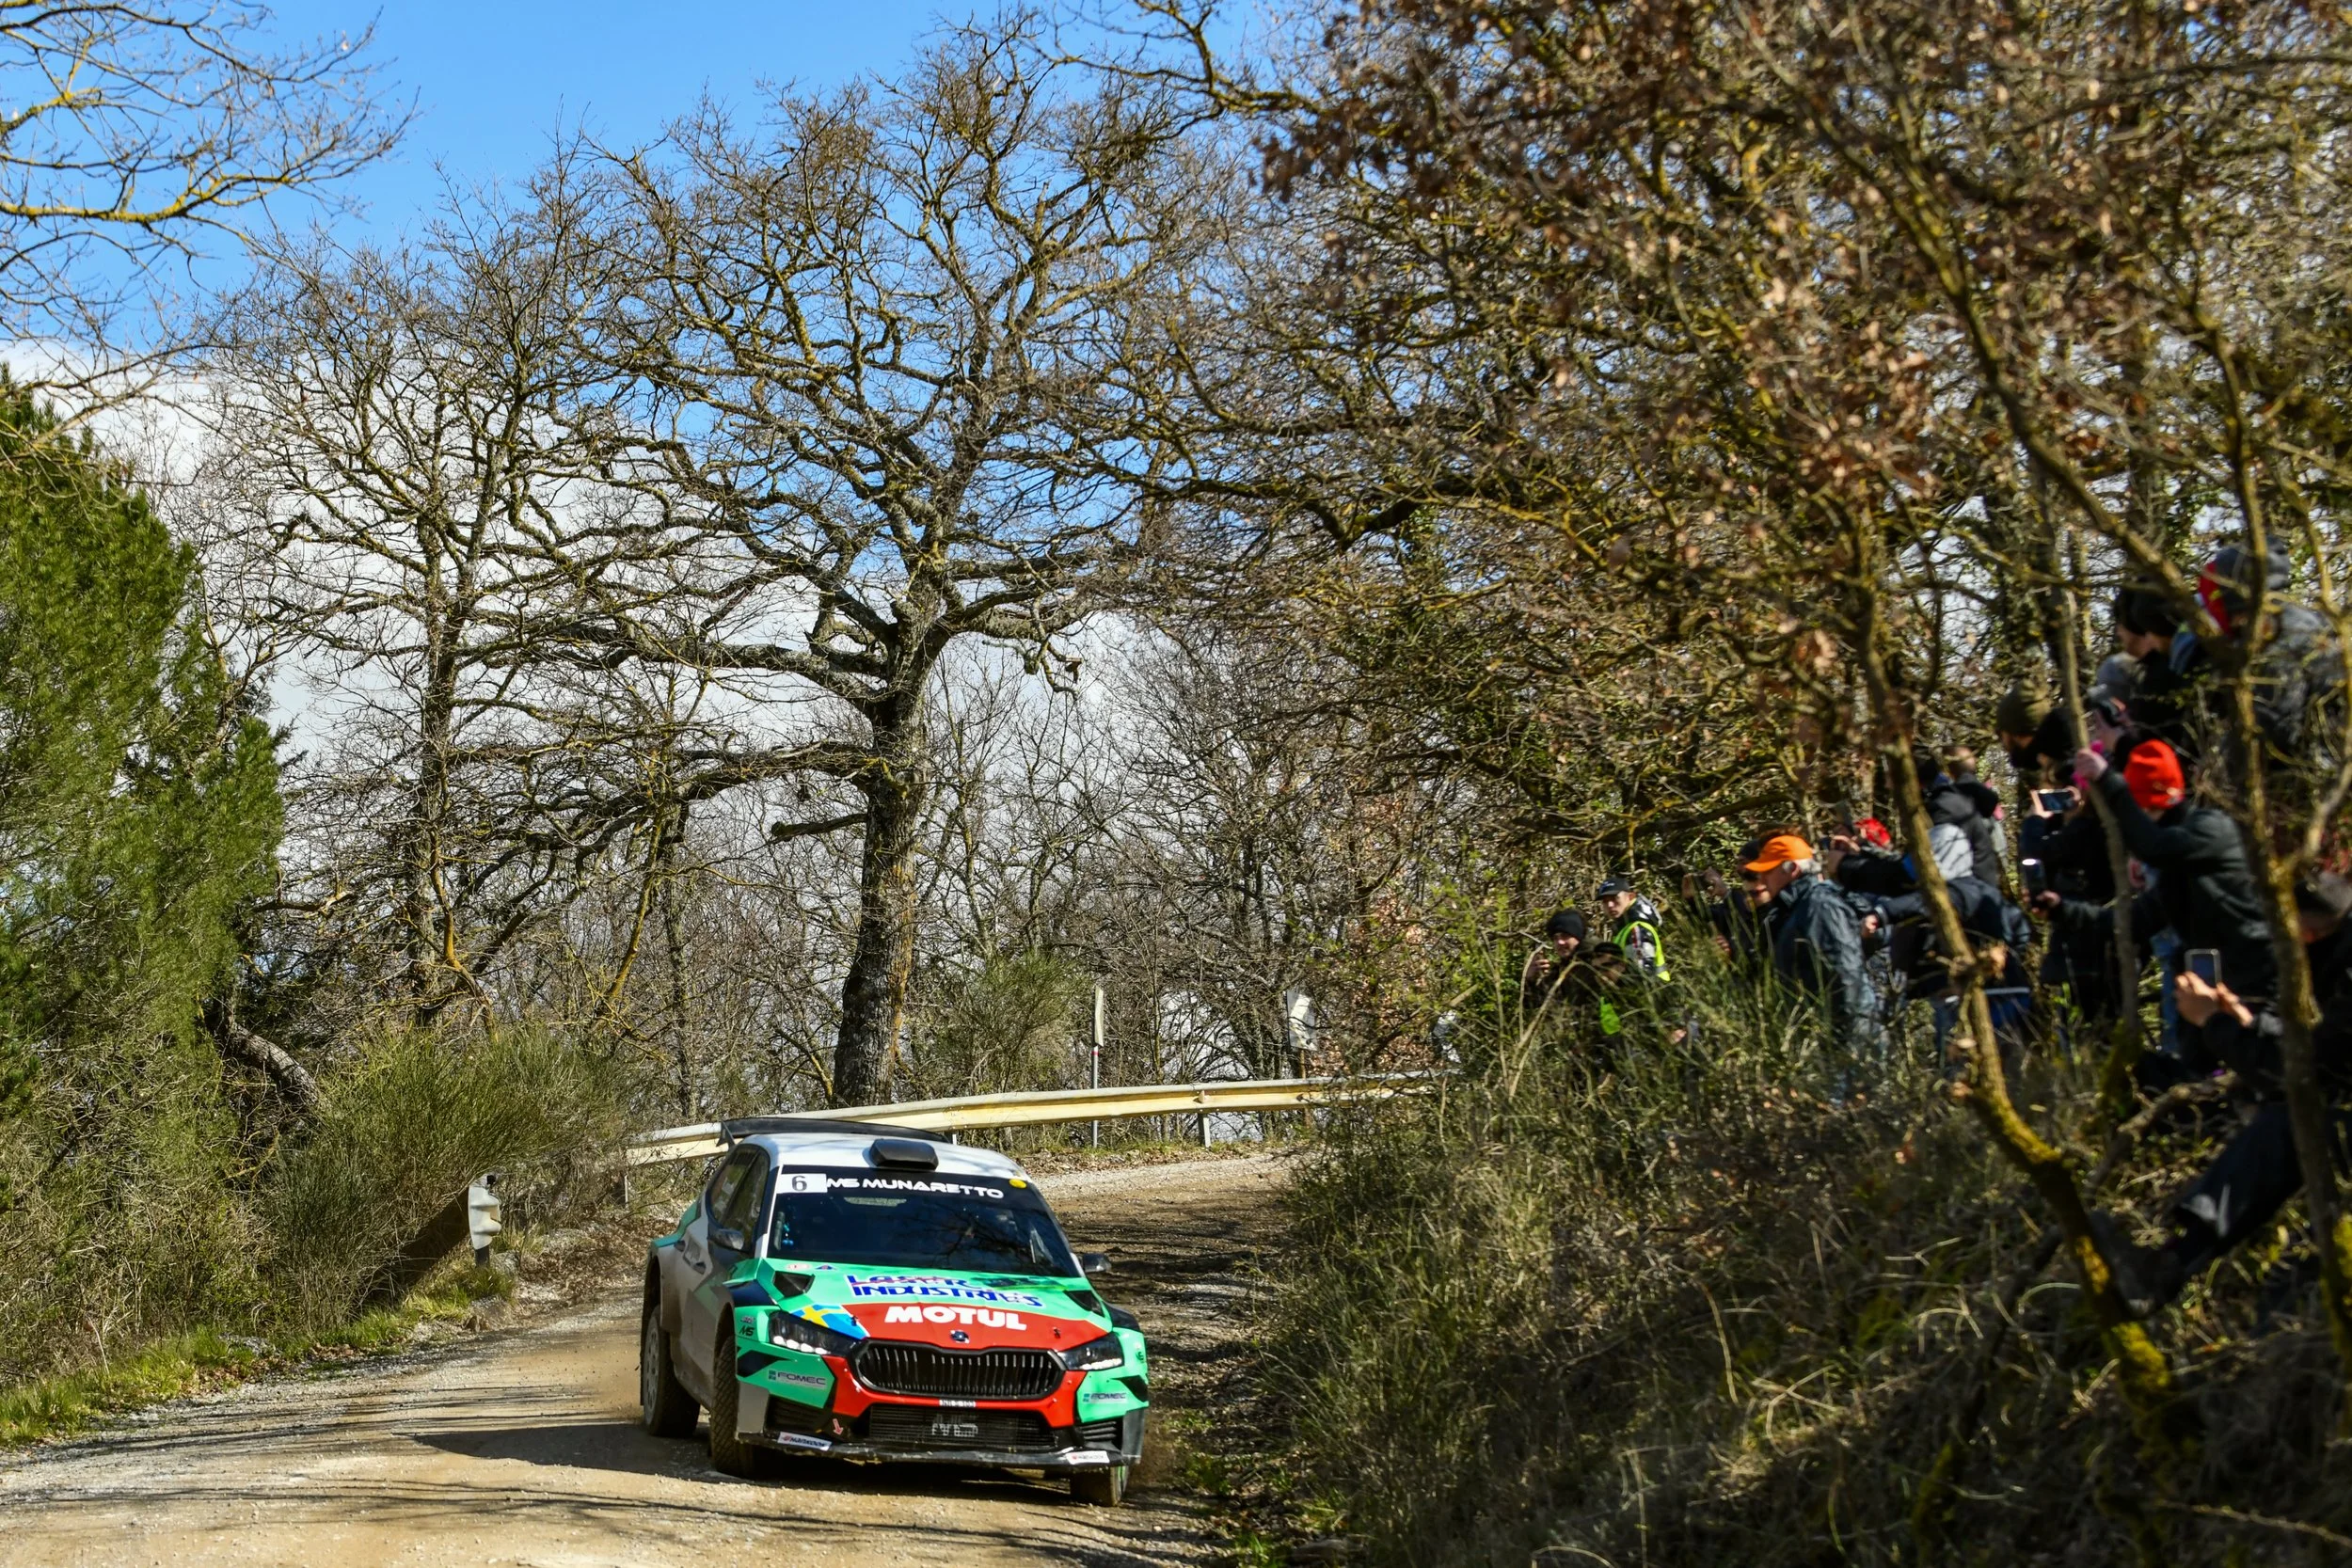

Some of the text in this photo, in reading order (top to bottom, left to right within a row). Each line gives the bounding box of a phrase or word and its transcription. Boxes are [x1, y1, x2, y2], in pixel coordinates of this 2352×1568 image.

[791, 1175, 808, 1192] 6
[863, 1179, 1004, 1198] MUNARETTO
[853, 1285, 1043, 1307] INDUSTRIES
[884, 1306, 1027, 1330] MOTUL
[777, 1371, 827, 1386] FOMEC
